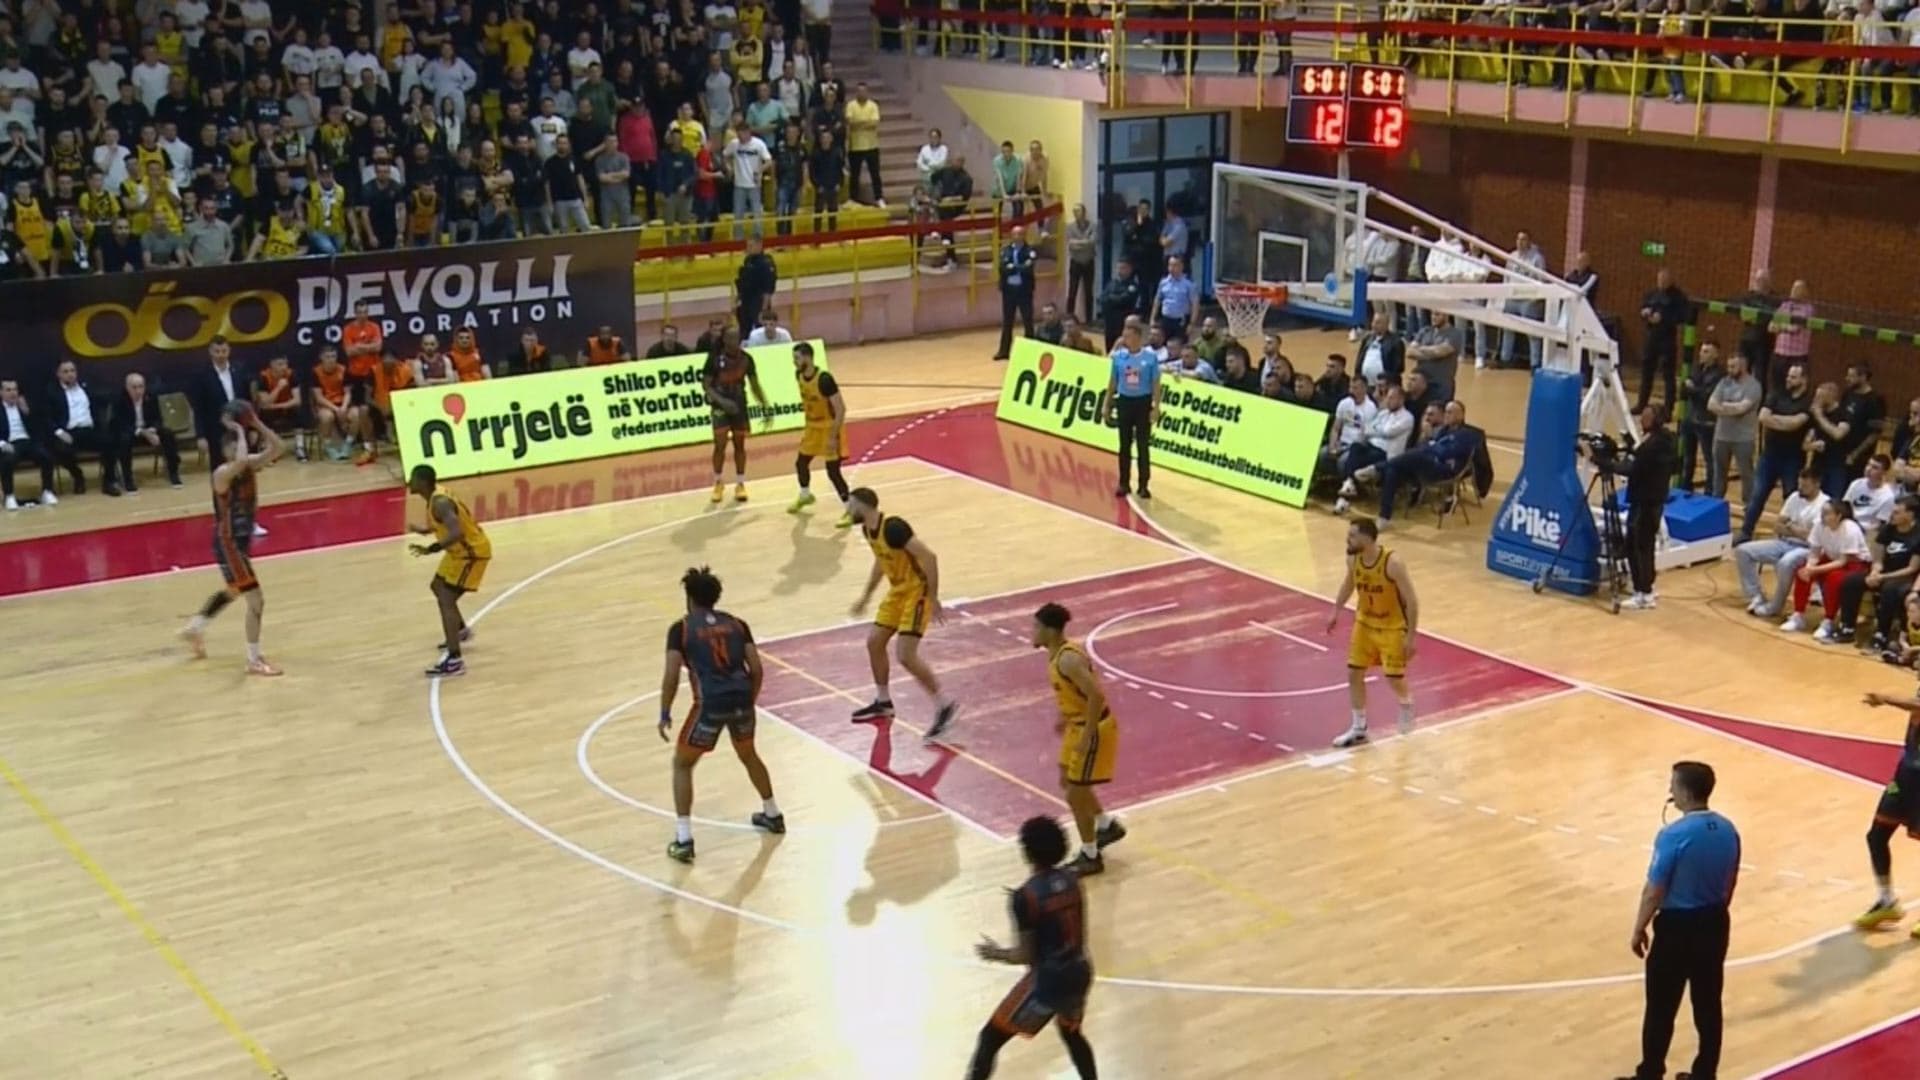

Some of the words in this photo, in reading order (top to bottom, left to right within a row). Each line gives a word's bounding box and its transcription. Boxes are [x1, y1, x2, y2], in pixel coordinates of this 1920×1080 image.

[1303, 67, 1347, 94] 6:01
[1362, 69, 1406, 97] 6:01
[1315, 103, 1344, 145] 12
[1373, 106, 1403, 148] 12
[297, 254, 573, 323] DEVOLLI
[297, 300, 574, 345] COPORATION
[603, 375, 656, 395] Shiko
[658, 366, 705, 386] Podc
[608, 400, 631, 419] në
[635, 390, 711, 416] YouTub
[1181, 391, 1242, 424] Podcast
[1511, 502, 1561, 542] Pikë
